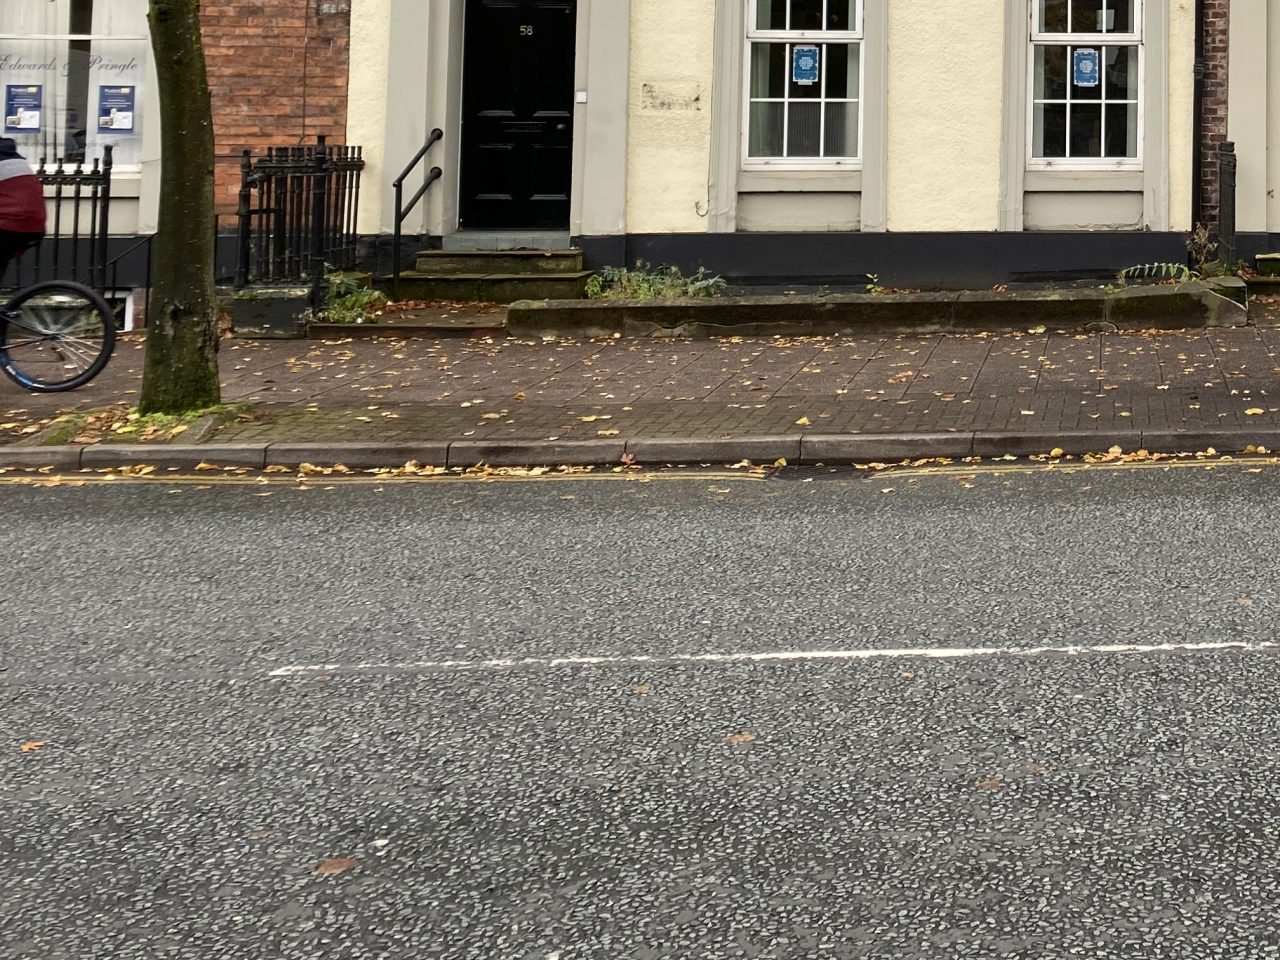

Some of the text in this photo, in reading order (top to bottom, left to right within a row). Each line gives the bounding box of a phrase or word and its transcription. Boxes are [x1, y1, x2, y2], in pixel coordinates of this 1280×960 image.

[520, 25, 533, 36] 58
[0, 55, 57, 71] Edwards
[86, 54, 138, 75] Pringle
